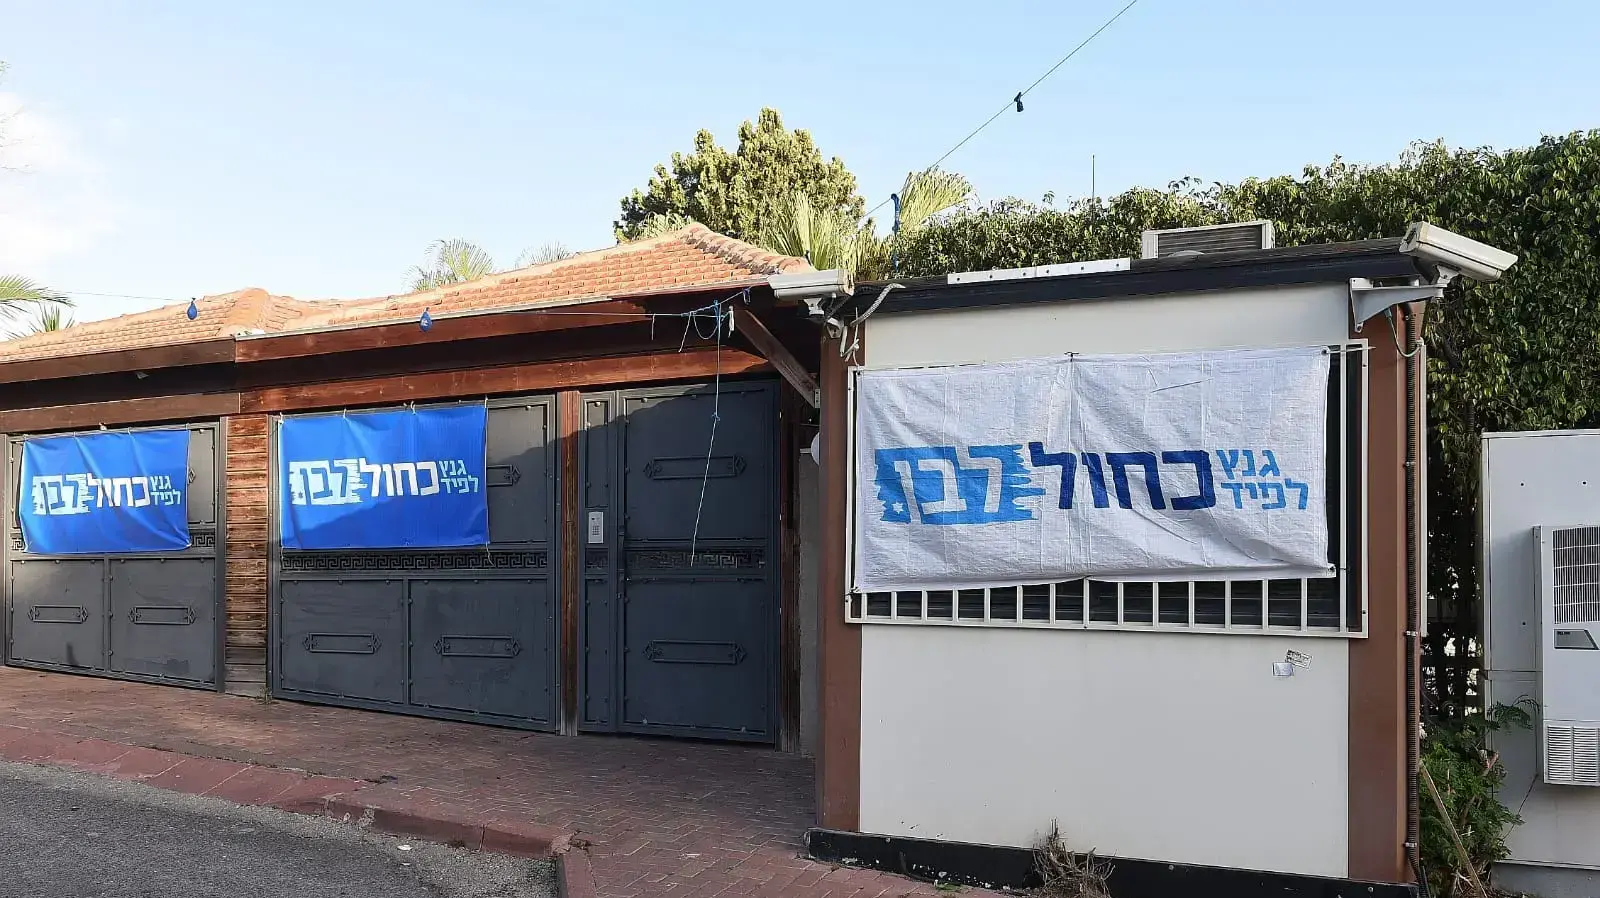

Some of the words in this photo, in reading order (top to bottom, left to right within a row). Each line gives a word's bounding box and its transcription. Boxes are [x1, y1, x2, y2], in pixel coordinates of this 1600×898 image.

[358, 457, 440, 498] כחול
[438, 459, 467, 477] גנץ
[1028, 441, 1216, 510] כחול
[1215, 449, 1280, 480] גנץ
[41, 474, 79, 515] לבן
[87, 472, 151, 507] כחול
[150, 475, 172, 491] גנץ
[150, 489, 181, 506] לפיד
[299, 458, 349, 505] לבן
[440, 475, 479, 494] לפיד
[894, 446, 1002, 524] לבן
[1221, 478, 1308, 510] לפיד
